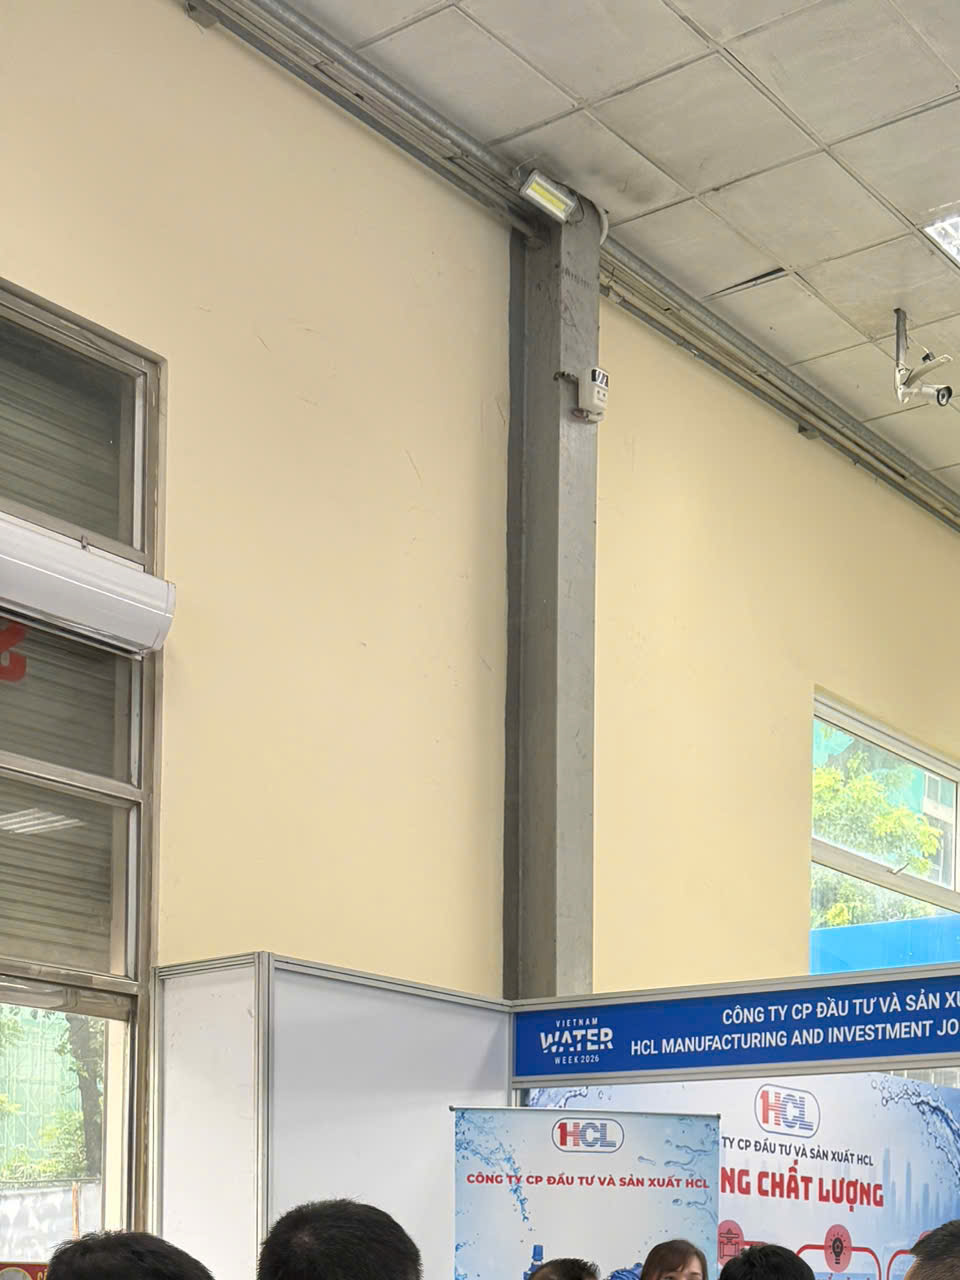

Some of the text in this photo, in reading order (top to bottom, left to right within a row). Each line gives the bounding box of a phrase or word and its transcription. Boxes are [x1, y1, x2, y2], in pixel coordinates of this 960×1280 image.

[722, 1005, 764, 1024] CÔNG
[768, 1004, 788, 1021] TY
[791, 1003, 813, 1020] CP
[816, 996, 849, 1018] ĐẦU
[852, 996, 877, 1016] TƯ
[879, 992, 901, 1013] VÀ
[905, 988, 940, 1011] SẢN
[556, 1017, 598, 1028] VIETNAM
[540, 1028, 613, 1053] WATER
[631, 1039, 658, 1057] HCL
[661, 1031, 787, 1055] MANUFACTURING
[791, 1028, 824, 1046] AND
[828, 1020, 933, 1043] INVESTMENT
[554, 1056, 579, 1065] WEEK
[721, 1136, 735, 1149] TY
[738, 1138, 751, 1151] CP
[779, 1143, 793, 1156] TƯ
[794, 1144, 808, 1159] VÀ
[831, 1149, 855, 1165] XUẤT
[857, 1153, 874, 1166] HCL
[466, 1171, 504, 1185] CÔNG
[506, 1174, 523, 1185] TY
[526, 1174, 544, 1186] CP
[577, 1175, 596, 1187] TƯ
[597, 1173, 616, 1187] VÀ
[619, 1174, 645, 1188] SẢN
[647, 1173, 683, 1188] XUẤT
[685, 1177, 710, 1189] HCL
[720, 1160, 884, 1212] NG CHẤT LƯỢNG
